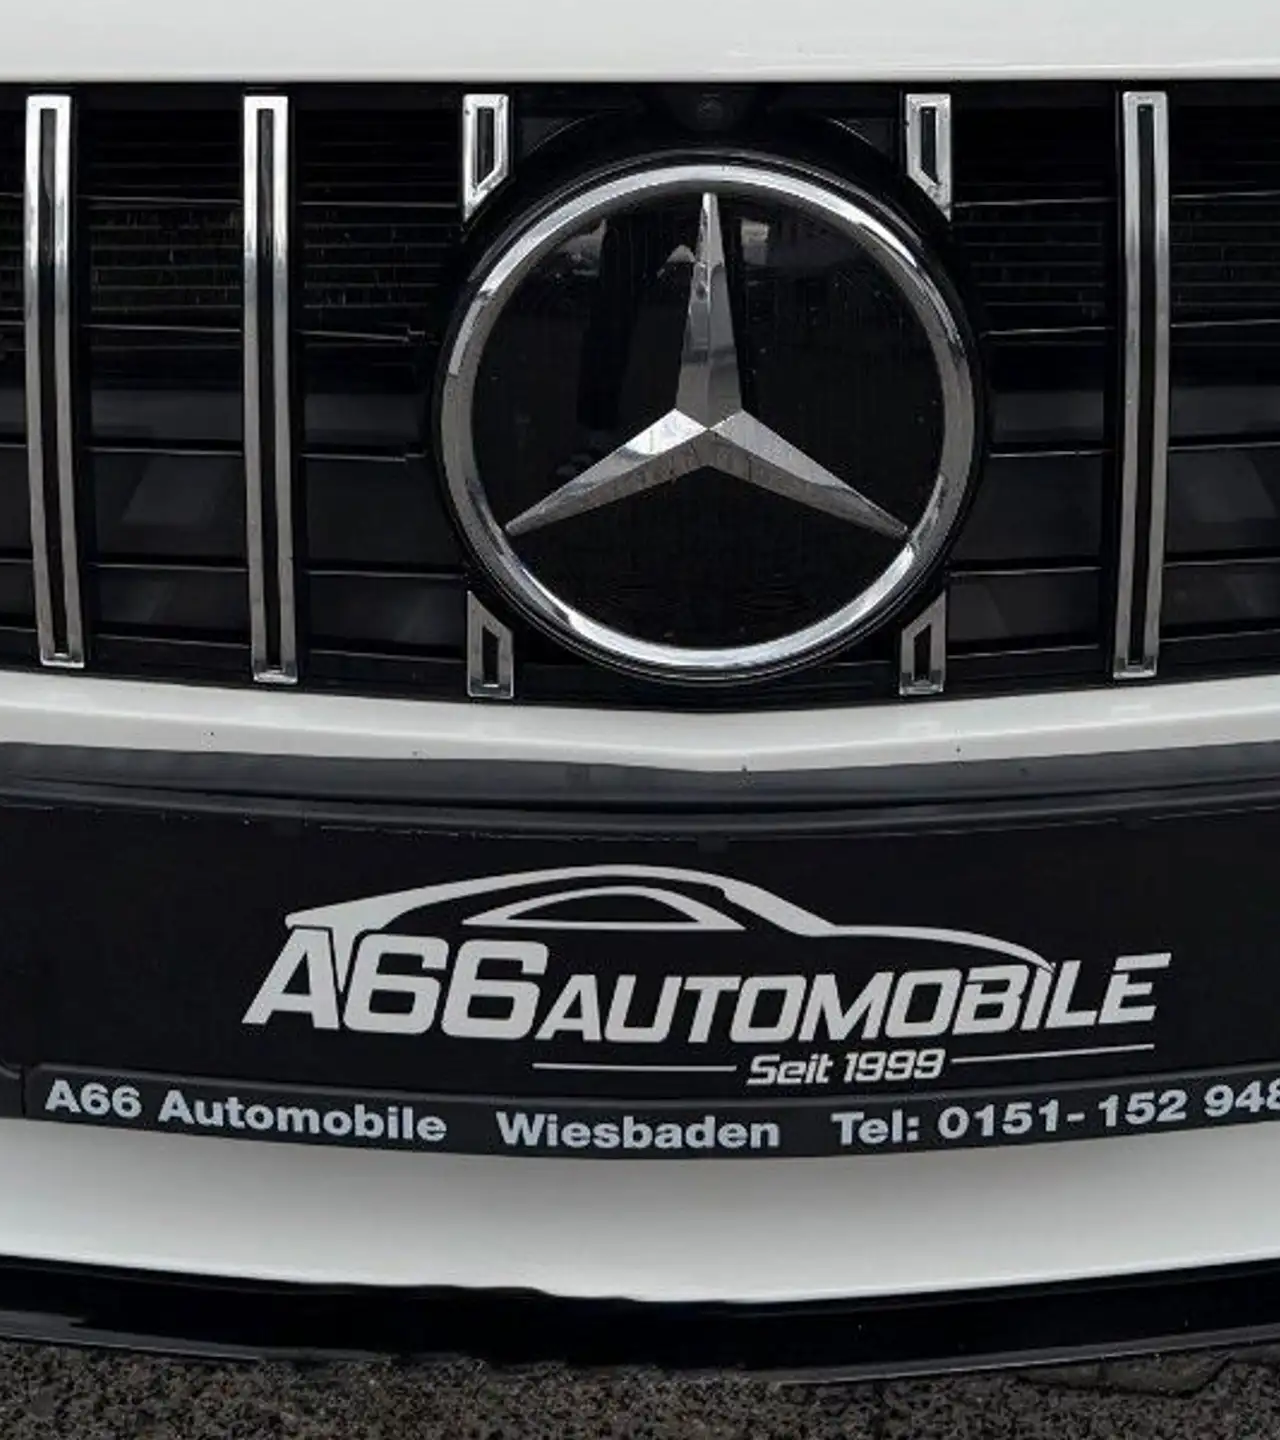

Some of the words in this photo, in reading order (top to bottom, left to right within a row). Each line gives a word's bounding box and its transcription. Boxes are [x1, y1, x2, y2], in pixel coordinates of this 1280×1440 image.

[747, 1053, 834, 1086] Seit
[843, 1048, 947, 1083] 1999
[45, 1078, 143, 1119] A66
[158, 1089, 448, 1142] Automobile
[495, 1110, 781, 1149] Wiesbaden
[830, 1108, 920, 1146] Tel:
